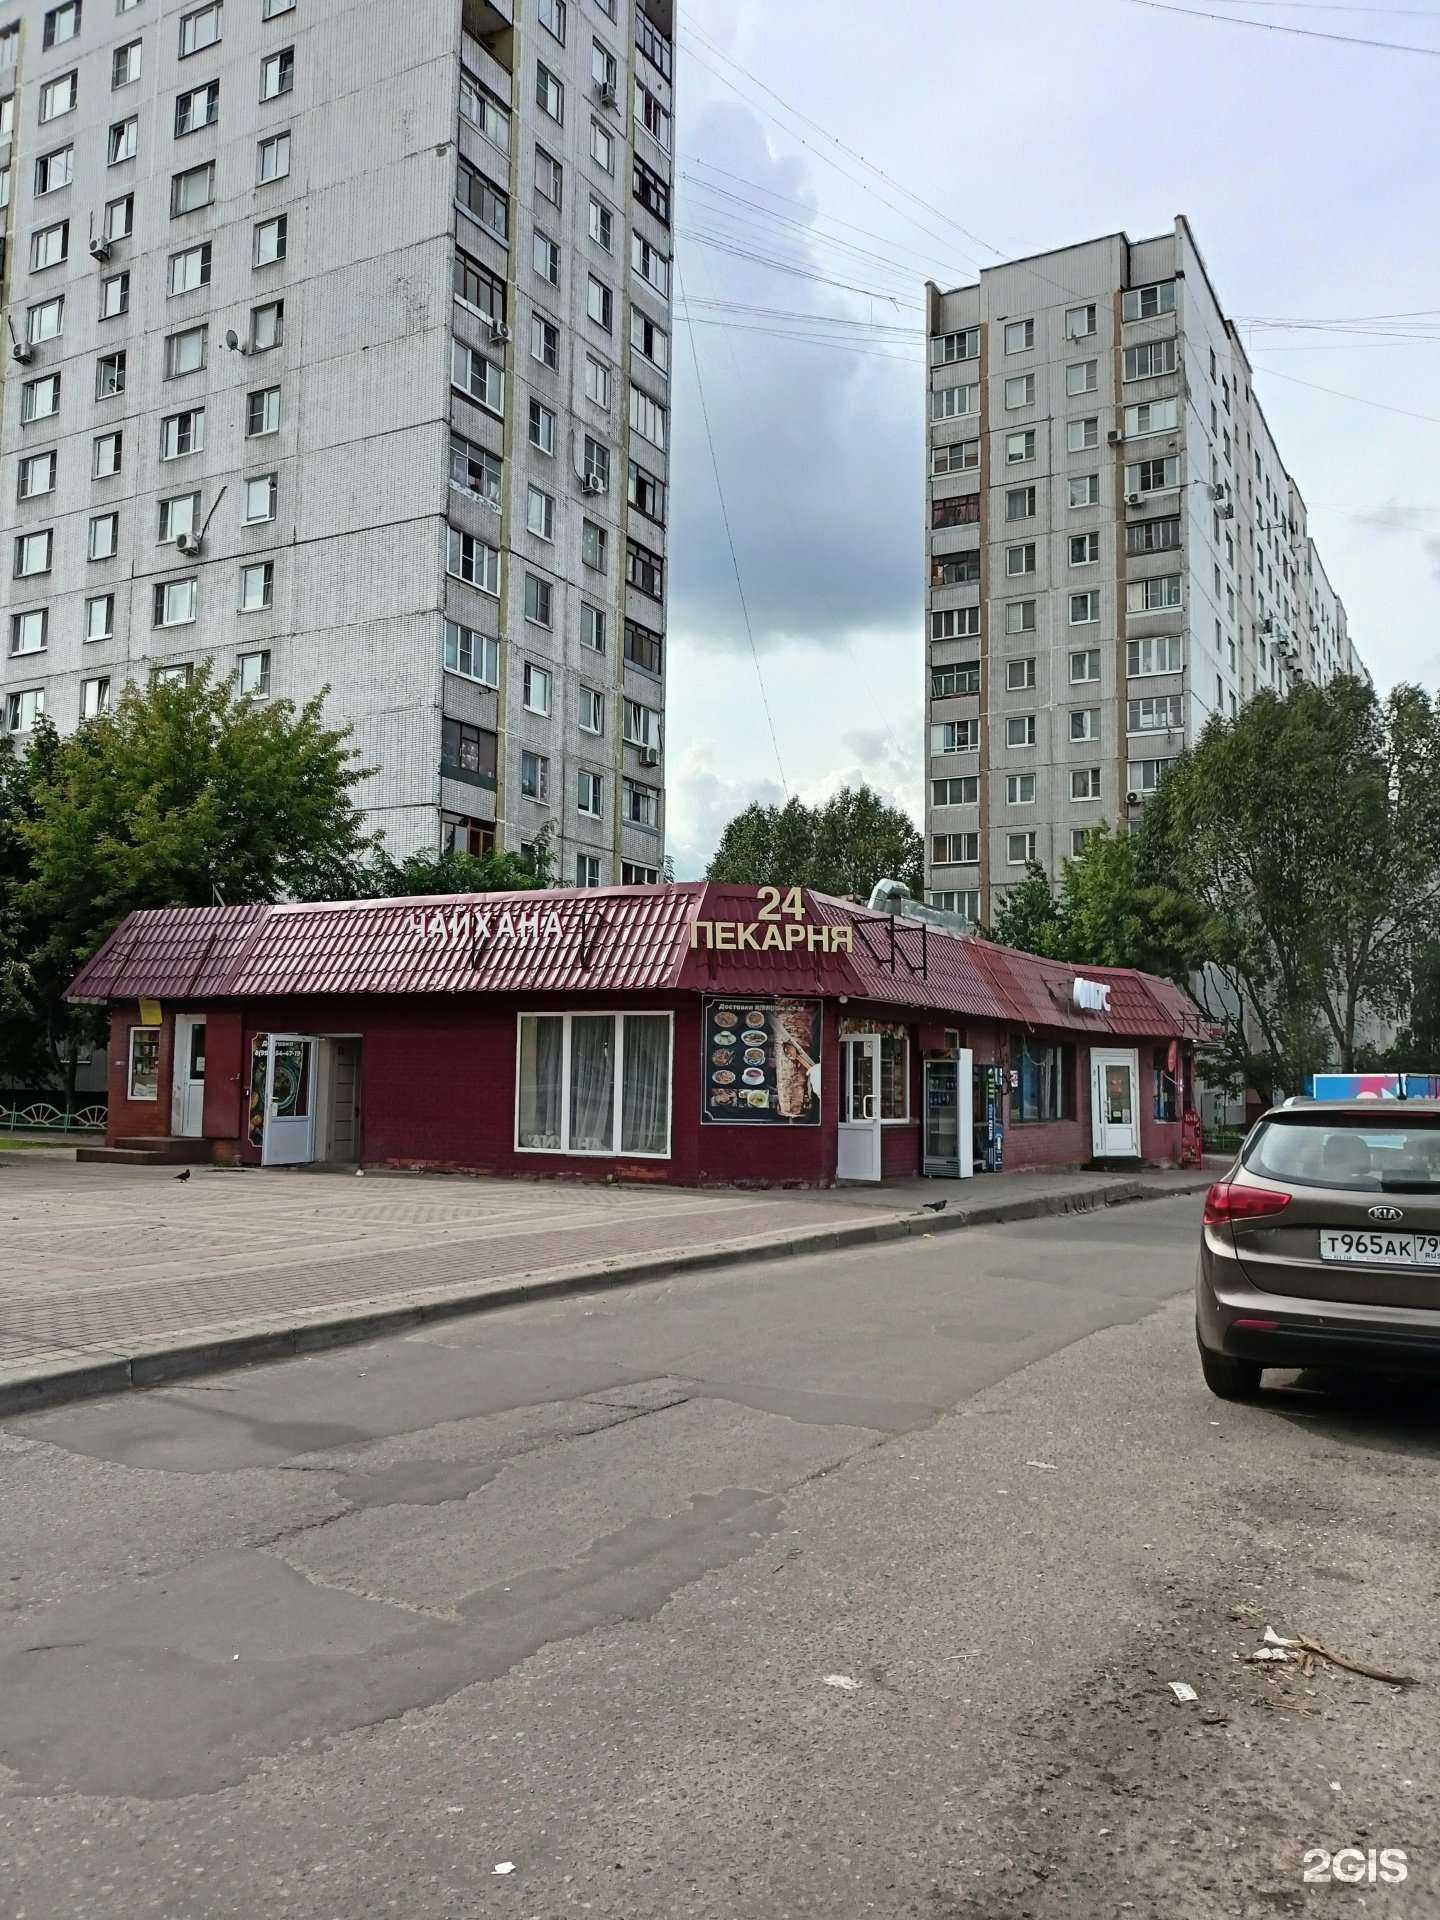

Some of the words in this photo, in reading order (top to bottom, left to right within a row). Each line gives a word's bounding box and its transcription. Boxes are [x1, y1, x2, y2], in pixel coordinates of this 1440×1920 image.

[757, 886, 805, 921] 24
[408, 905, 564, 938] ЧАЙХАНА
[689, 920, 853, 953] ПЕКАРНЯ
[1374, 1208, 1398, 1219] KIA
